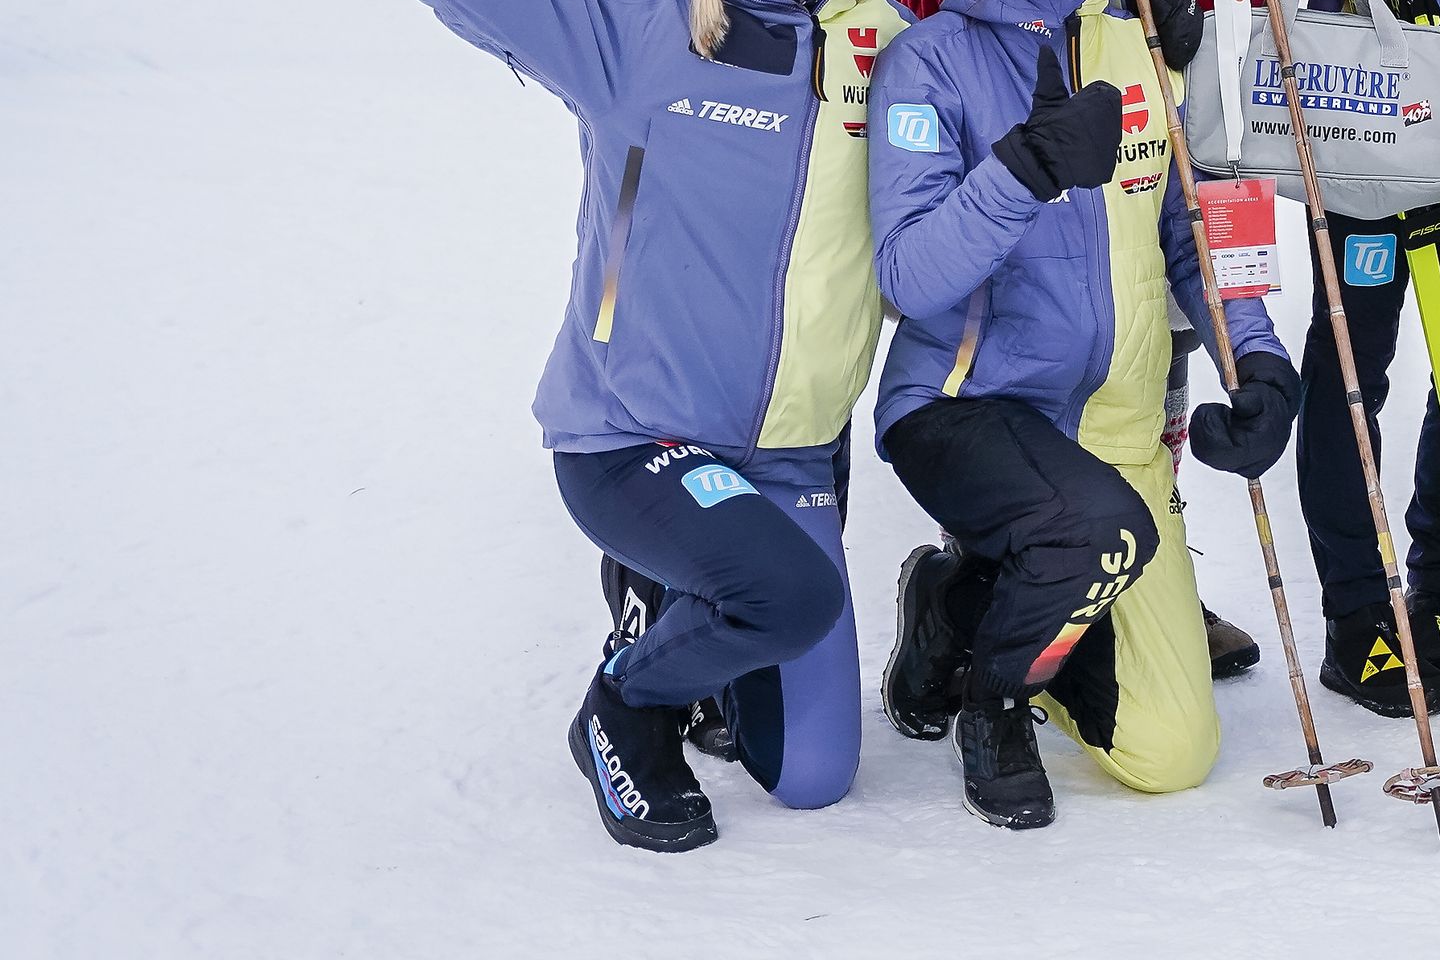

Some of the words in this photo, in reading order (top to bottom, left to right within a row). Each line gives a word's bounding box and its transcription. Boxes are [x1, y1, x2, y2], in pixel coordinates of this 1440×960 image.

[1253, 59, 1281, 88] LE
[1293, 62, 1400, 100] GRUYÈRE
[698, 100, 790, 133] TERREX
[1258, 92, 1392, 114] SWTZERLAND
[1403, 107, 1431, 122] AOP
[897, 110, 934, 148] TQ
[1251, 120, 1397, 144] www.ruyere.com
[1353, 242, 1388, 279] TQ
[693, 469, 748, 492] TQ
